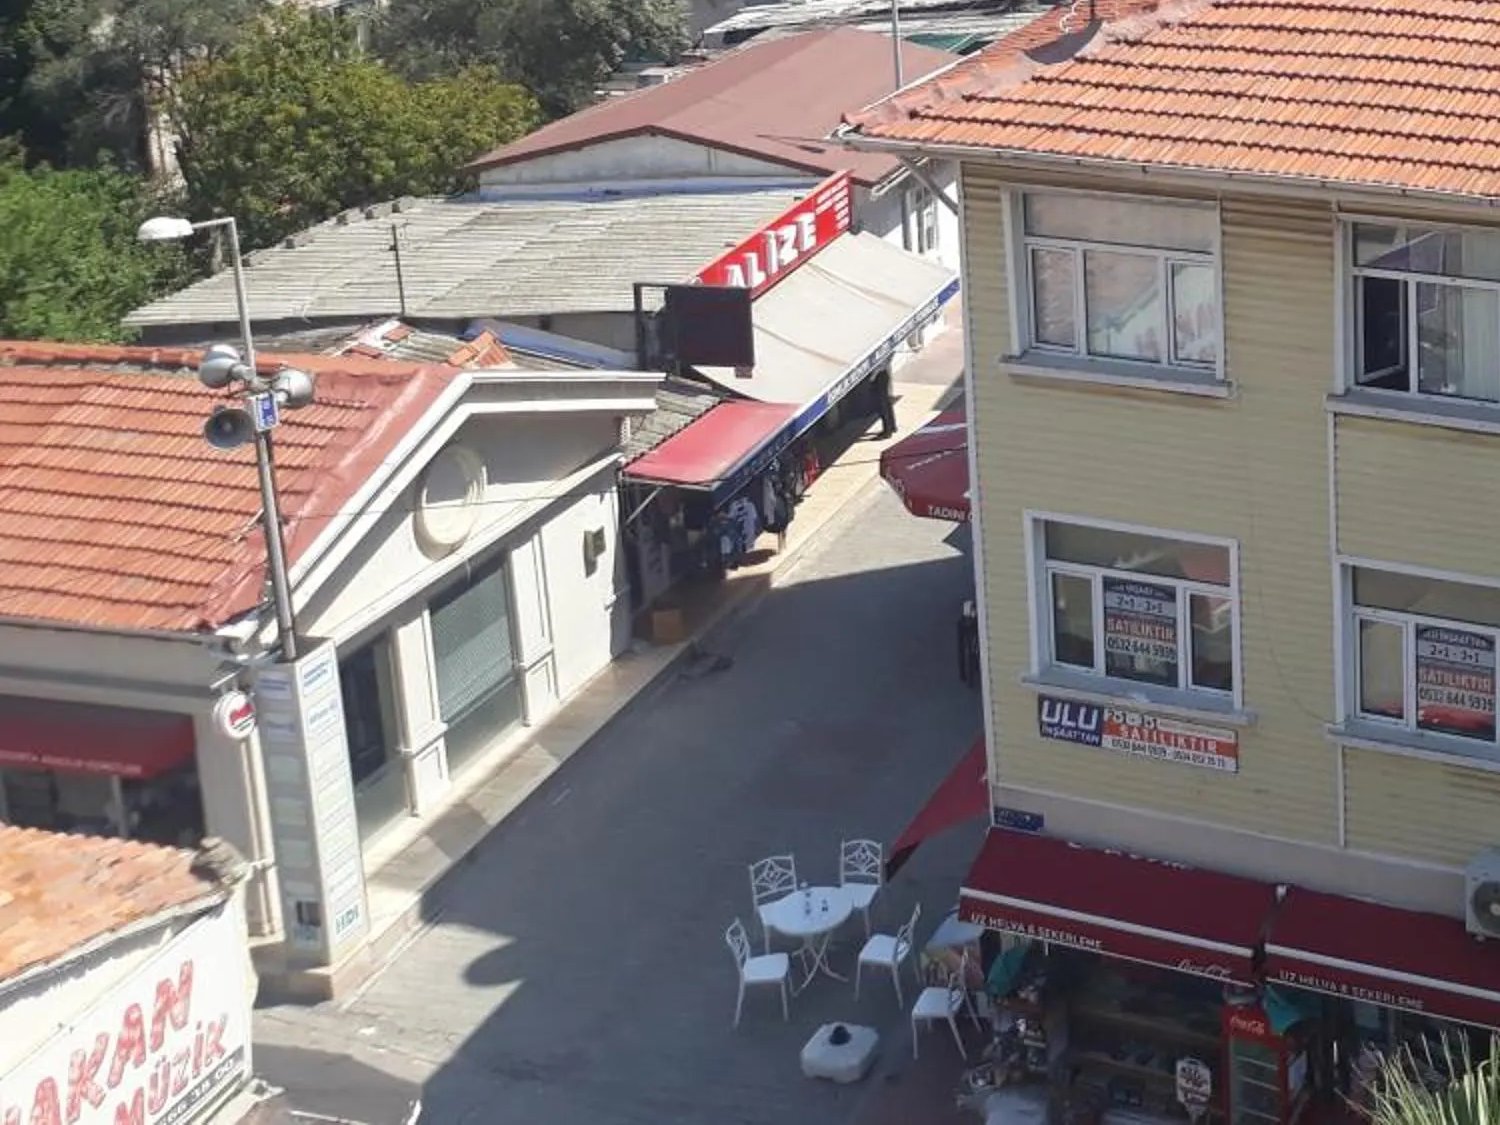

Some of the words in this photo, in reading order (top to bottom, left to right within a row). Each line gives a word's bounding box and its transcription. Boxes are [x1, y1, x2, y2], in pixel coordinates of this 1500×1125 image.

[1041, 699, 1098, 730] ULU
[1119, 724, 1217, 752] SATILIKTIR
[4, 959, 194, 1125] AKAN
